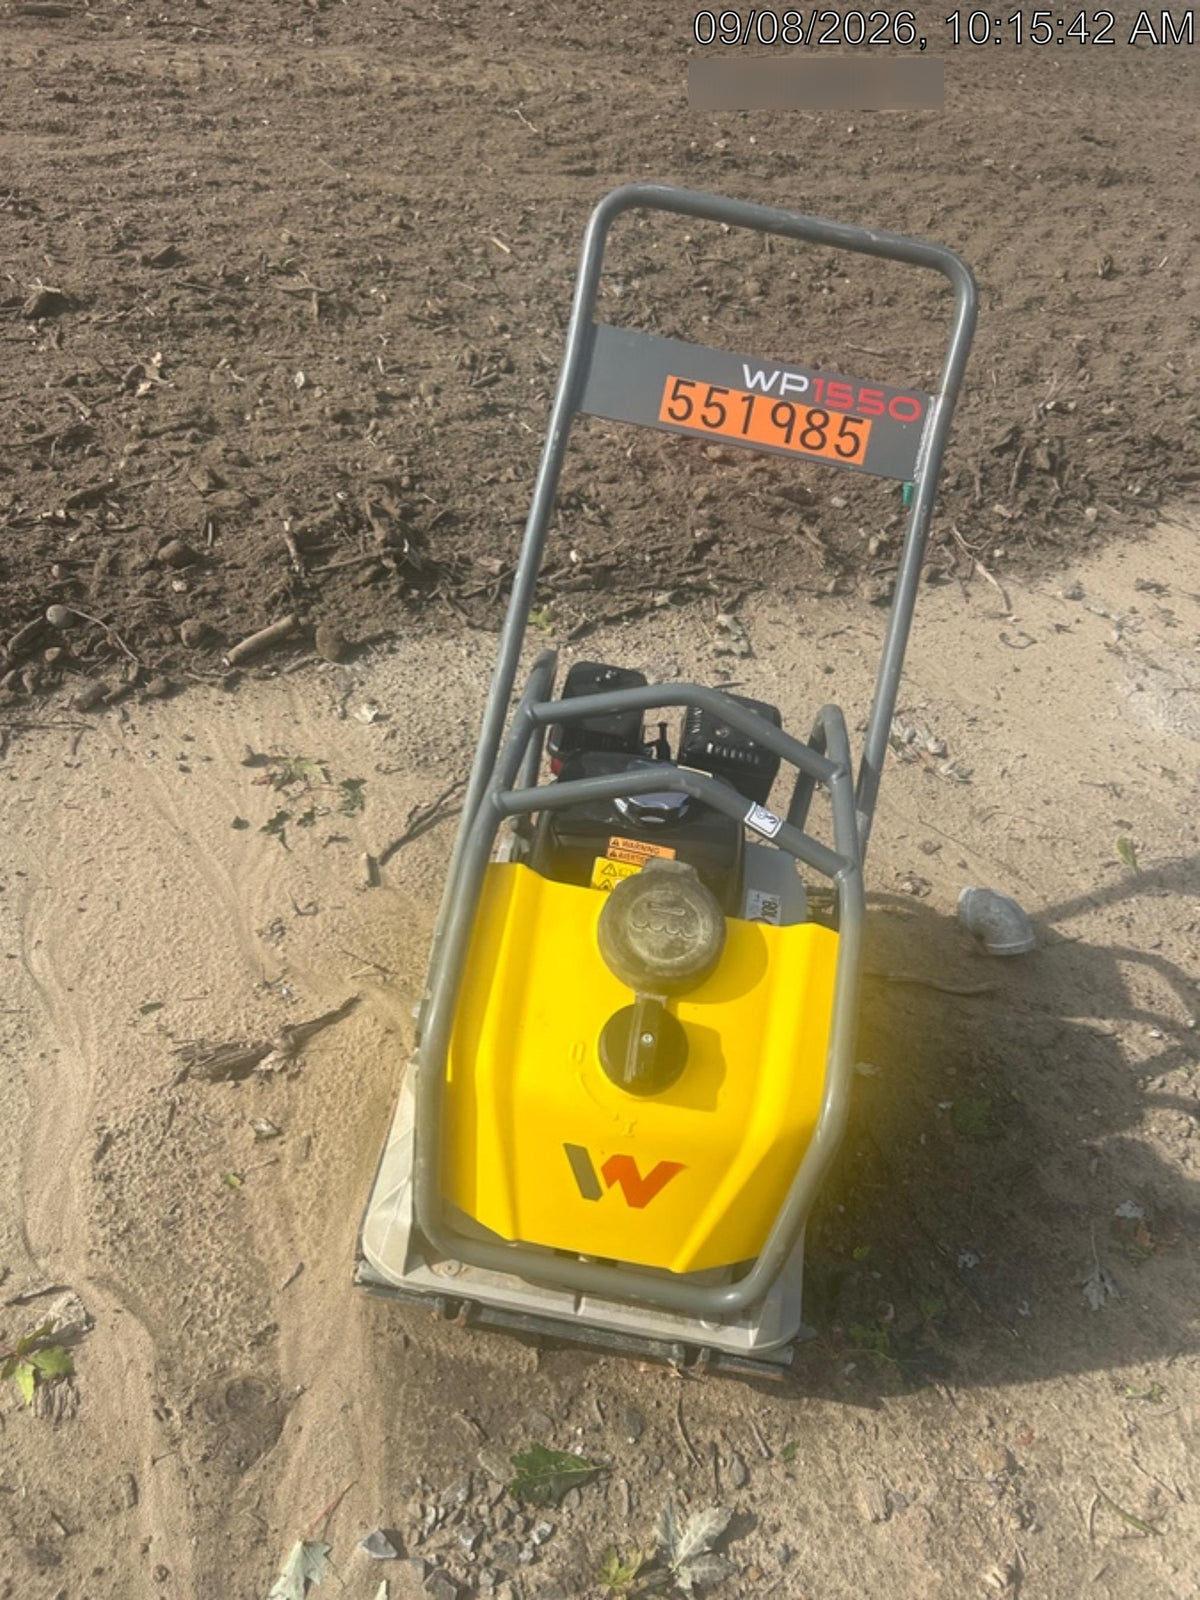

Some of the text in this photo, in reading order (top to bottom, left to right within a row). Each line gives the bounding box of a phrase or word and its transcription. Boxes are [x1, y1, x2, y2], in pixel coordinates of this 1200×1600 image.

[666, 377, 865, 459] 551985
[742, 363, 923, 423] WP1550
[621, 840, 661, 856] WARNING
